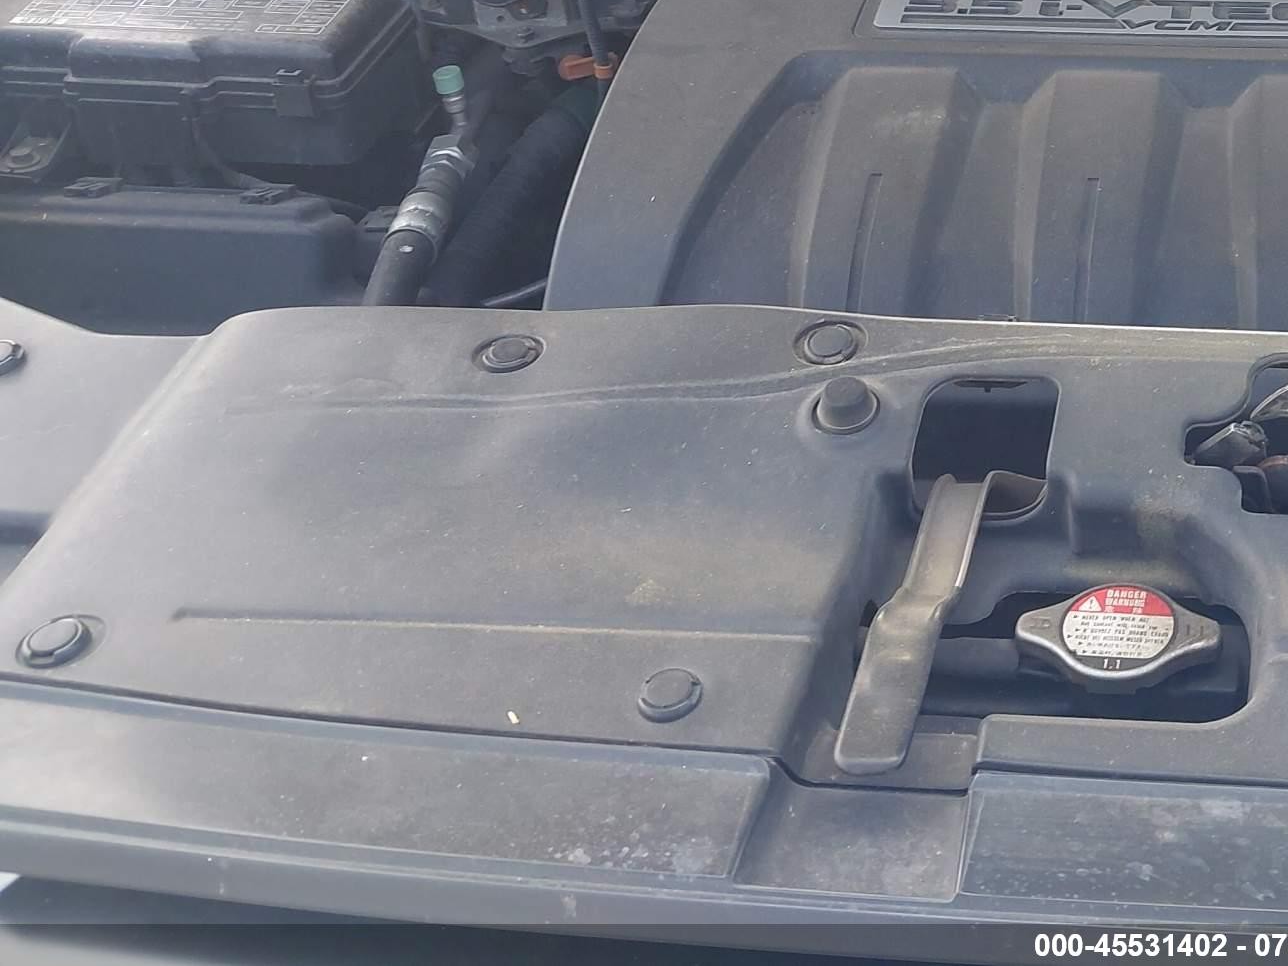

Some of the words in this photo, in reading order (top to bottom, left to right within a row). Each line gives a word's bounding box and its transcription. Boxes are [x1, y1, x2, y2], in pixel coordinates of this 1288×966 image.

[1119, 19, 1233, 32] VCM
[1106, 589, 1147, 599] DANGER
[1104, 597, 1146, 608] WARNING
